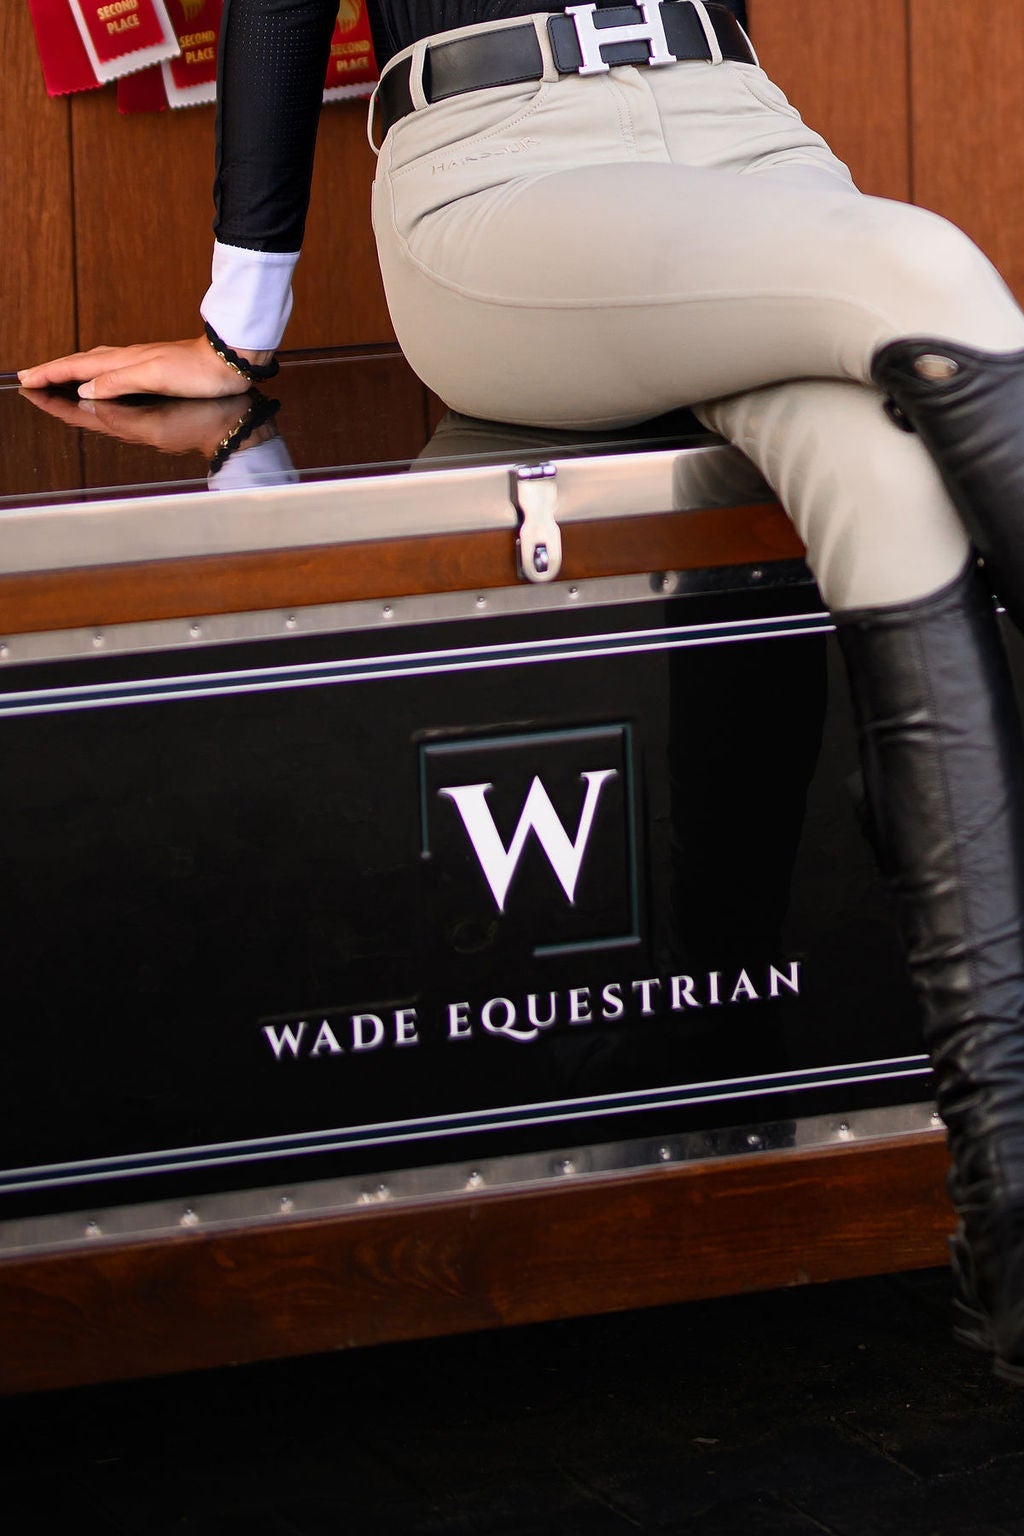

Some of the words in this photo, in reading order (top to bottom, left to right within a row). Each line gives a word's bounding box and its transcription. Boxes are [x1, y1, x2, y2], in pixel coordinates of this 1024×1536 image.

[106, 14, 140, 35] PLACE
[180, 30, 215, 48] SECOND
[186, 47, 214, 63] PLACE
[336, 57, 369, 72] PLACE
[437, 768, 618, 913] W
[262, 1008, 420, 1060] WADE
[448, 961, 801, 1043] EQUESTRIAN
